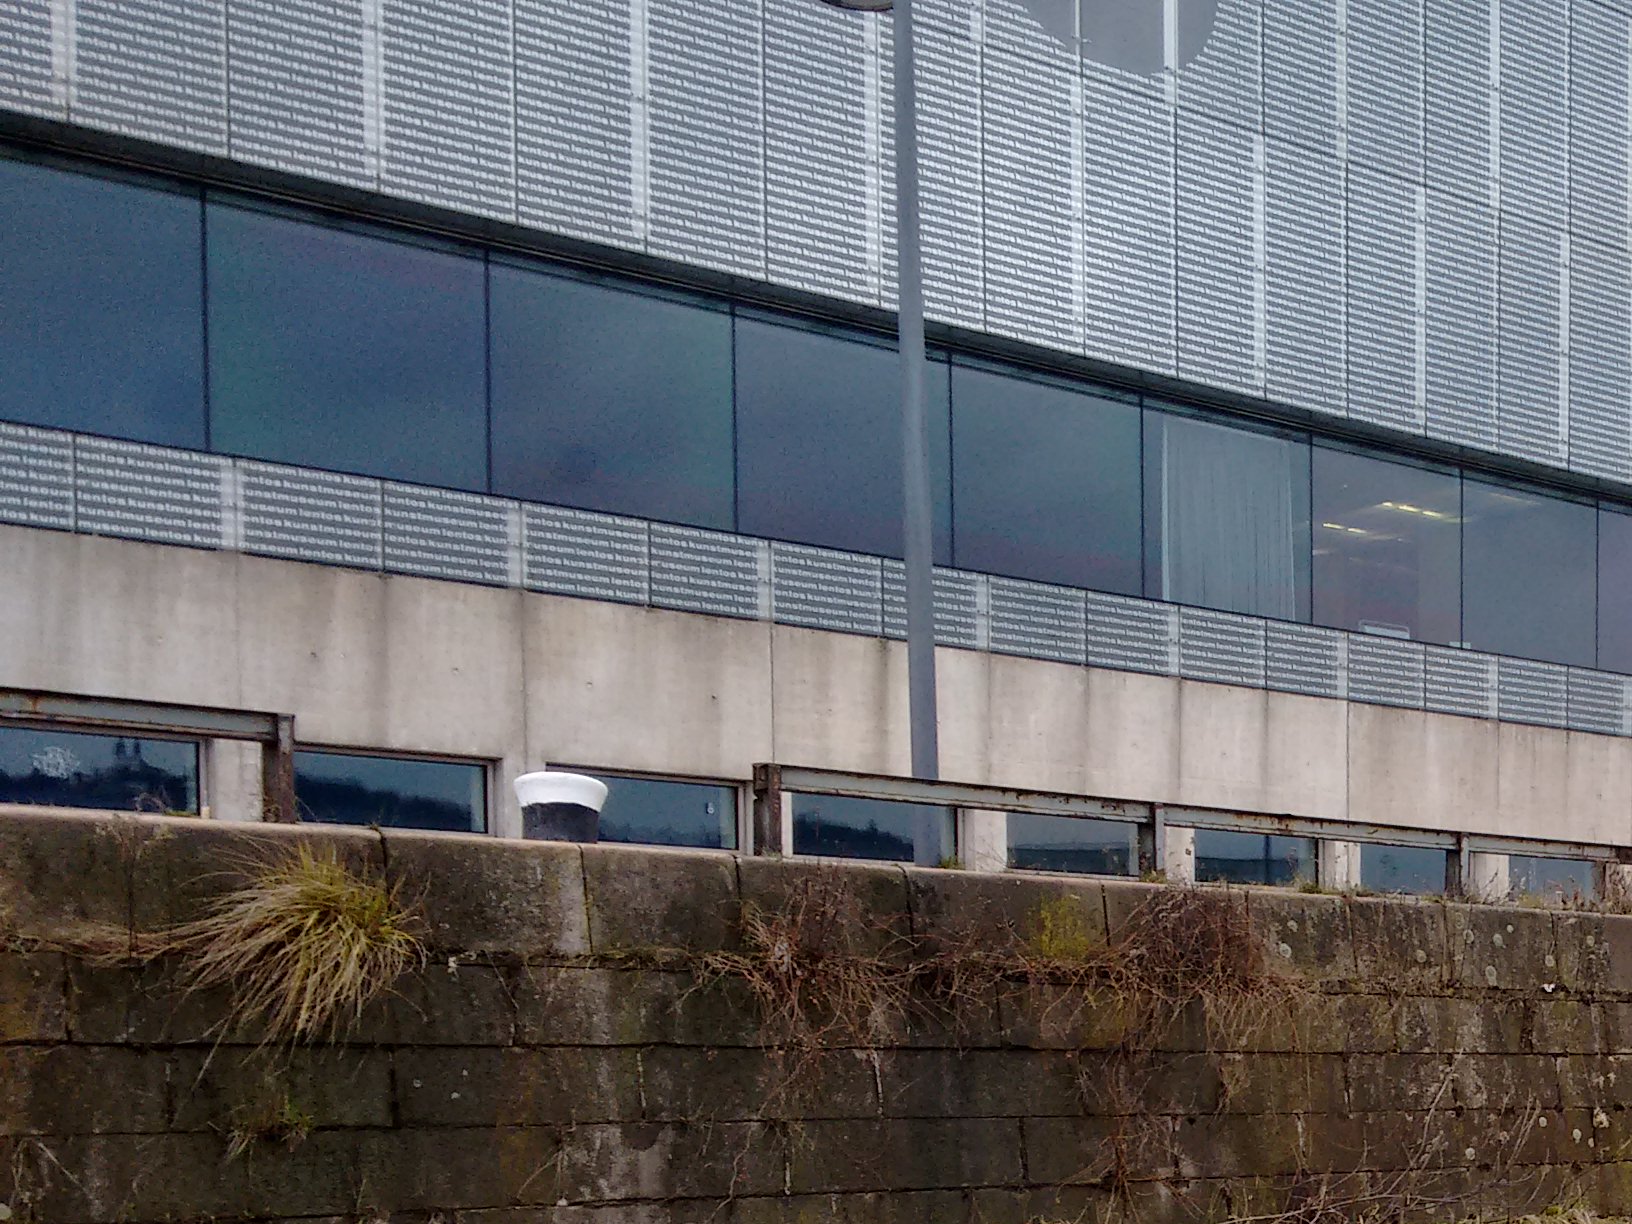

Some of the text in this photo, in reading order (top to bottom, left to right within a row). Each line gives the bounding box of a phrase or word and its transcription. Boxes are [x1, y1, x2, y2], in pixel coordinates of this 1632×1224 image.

[0, 423, 26, 436] tos
[0, 437, 72, 456] tmuseum
[0, 466, 27, 478] tos
[0, 480, 73, 499] tmuseum
[186, 477, 232, 492] lento
[0, 508, 27, 521] tos
[187, 517, 233, 533] lento
[479, 520, 519, 534] lento
[480, 558, 519, 572] lento
[733, 557, 768, 570] lent
[734, 593, 769, 606] lent
[772, 588, 806, 600] entos
